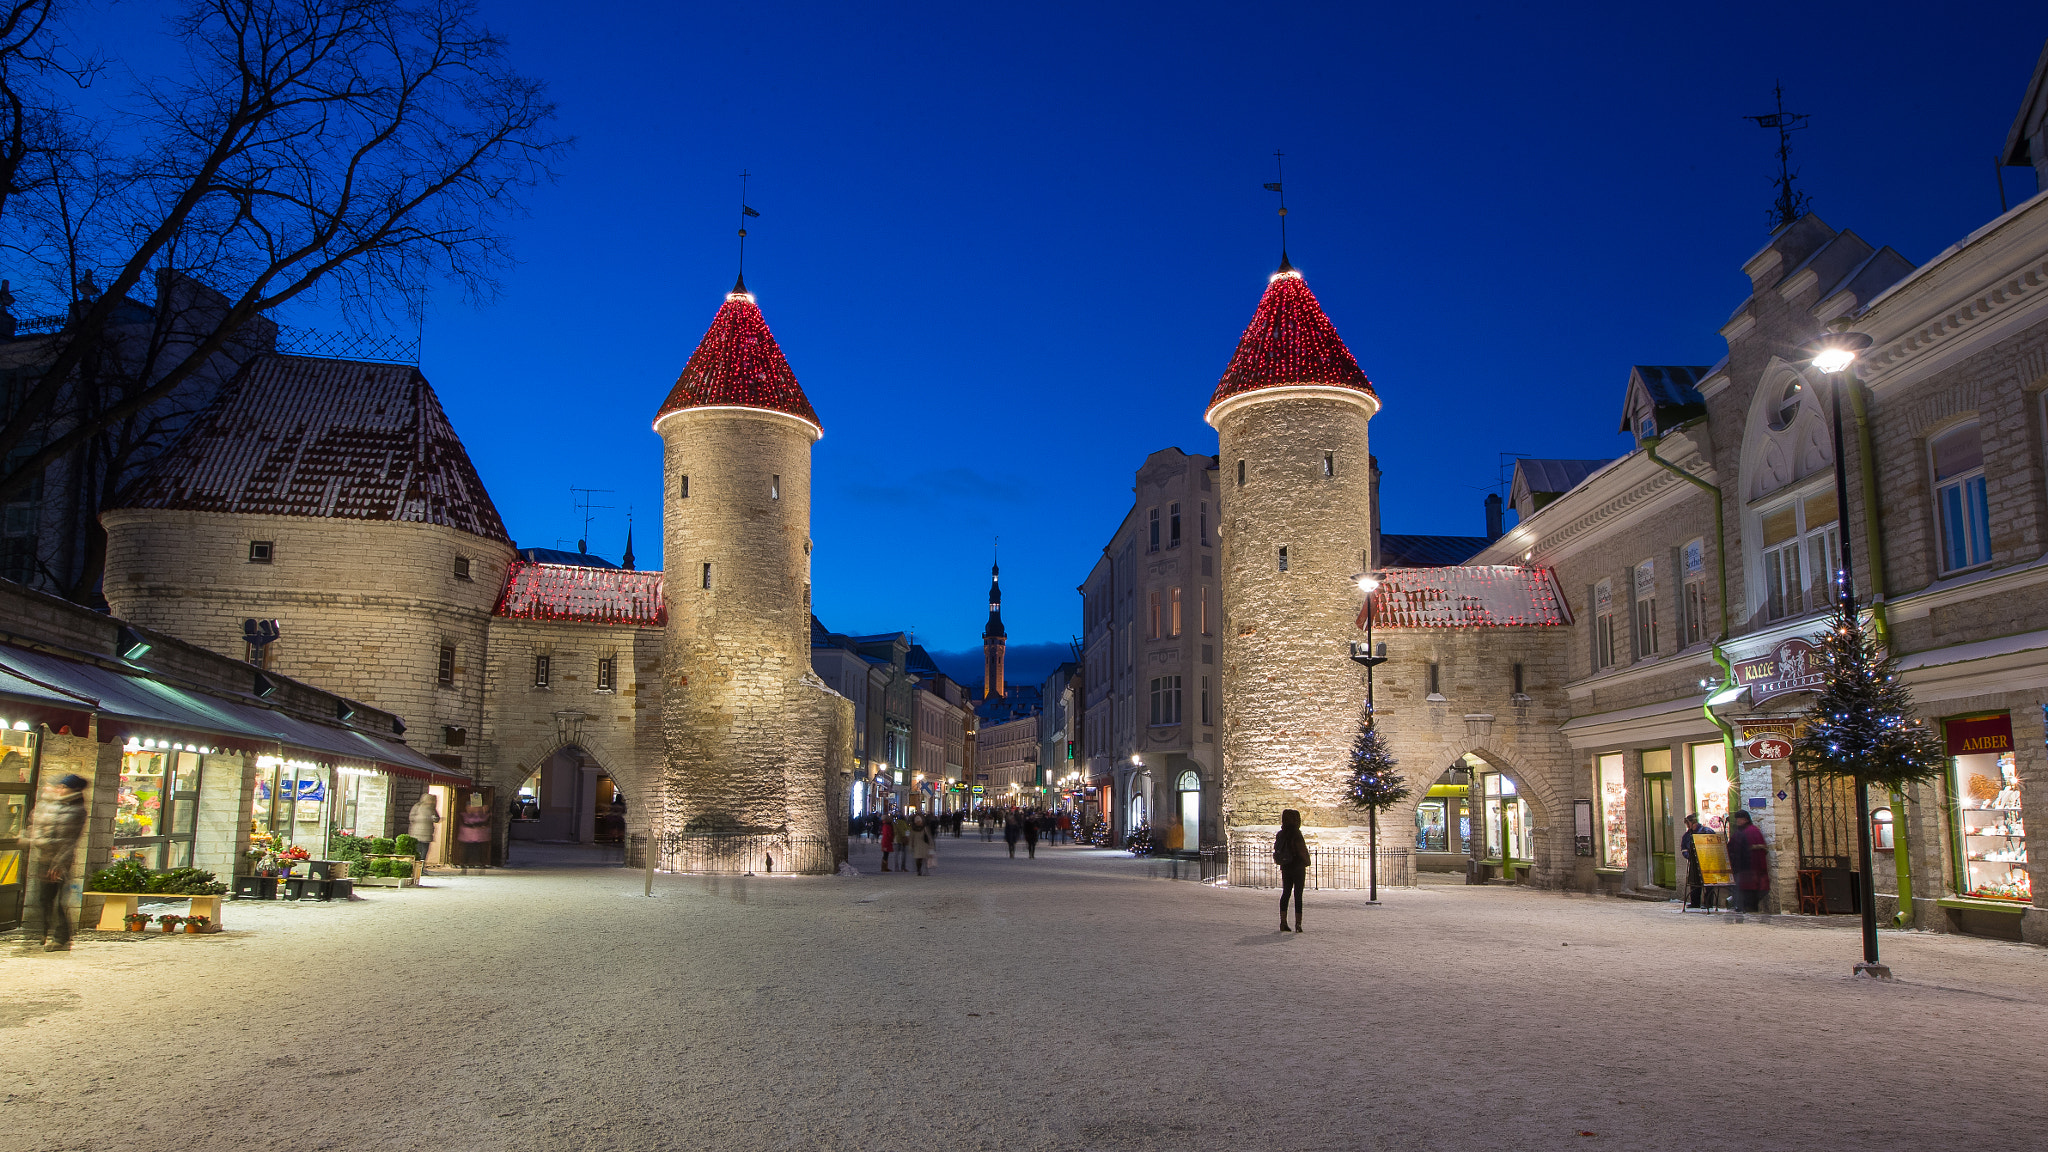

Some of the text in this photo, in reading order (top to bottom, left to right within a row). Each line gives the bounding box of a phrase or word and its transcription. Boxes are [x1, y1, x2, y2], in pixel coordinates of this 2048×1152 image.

[1685, 548, 1699, 559] Baltic
[1745, 662, 1774, 681] KALLE
[1962, 735, 2008, 751] AMBER
